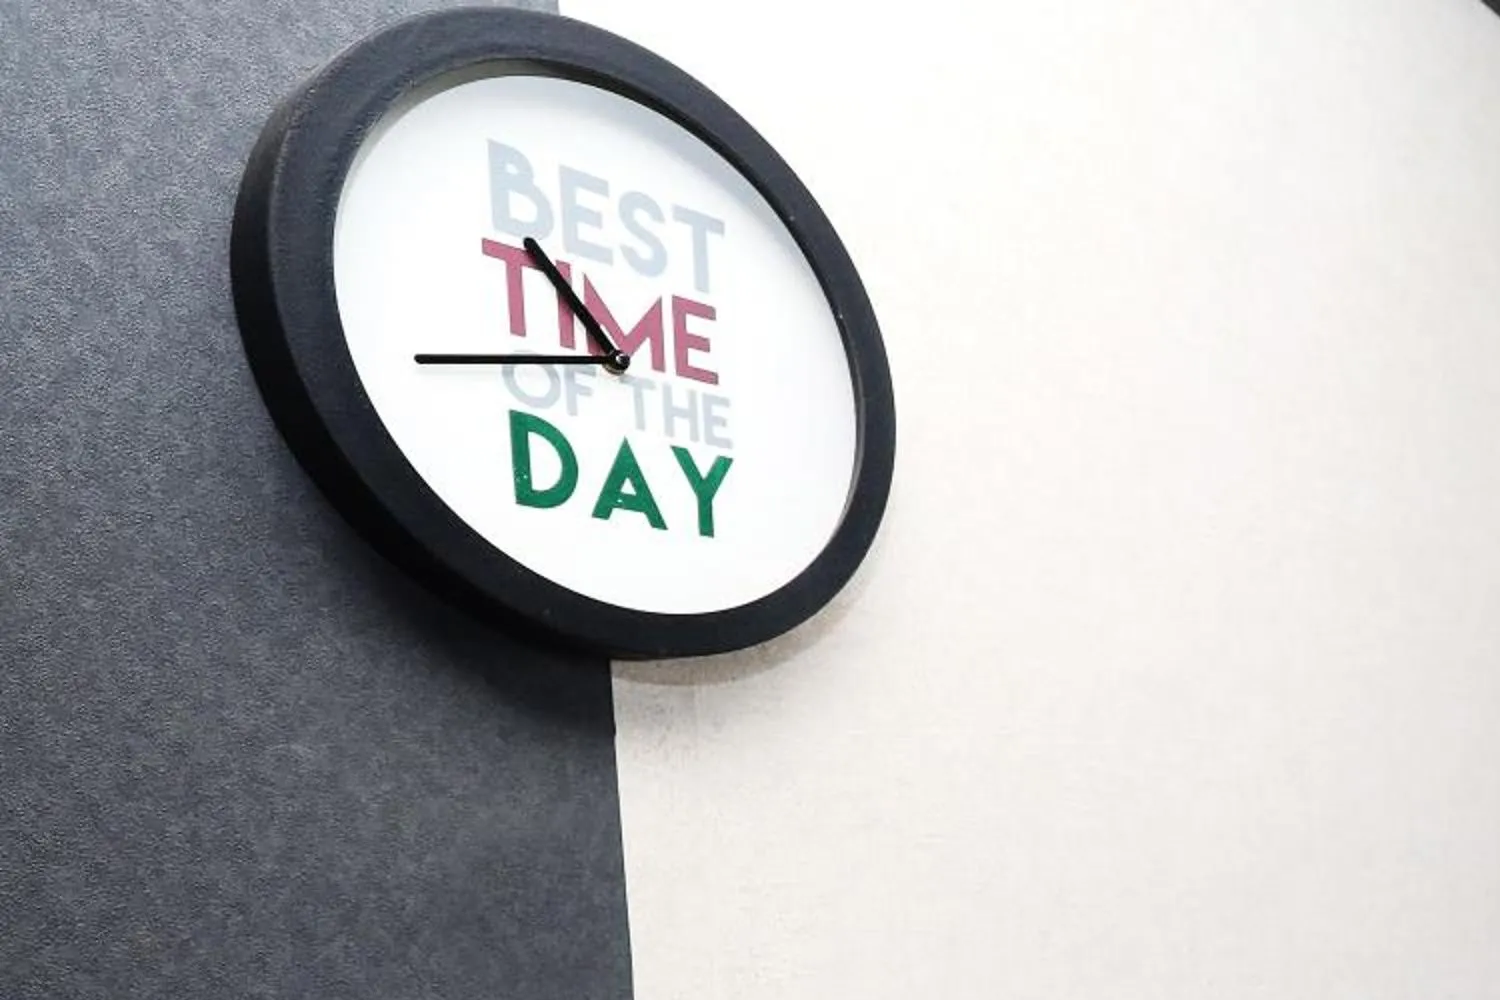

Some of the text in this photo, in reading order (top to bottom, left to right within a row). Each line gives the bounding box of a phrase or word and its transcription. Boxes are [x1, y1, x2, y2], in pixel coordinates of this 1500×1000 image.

[487, 138, 725, 293] BEST
[482, 237, 719, 385] TIME
[501, 349, 733, 449] OF THE
[508, 409, 733, 538] DAY
